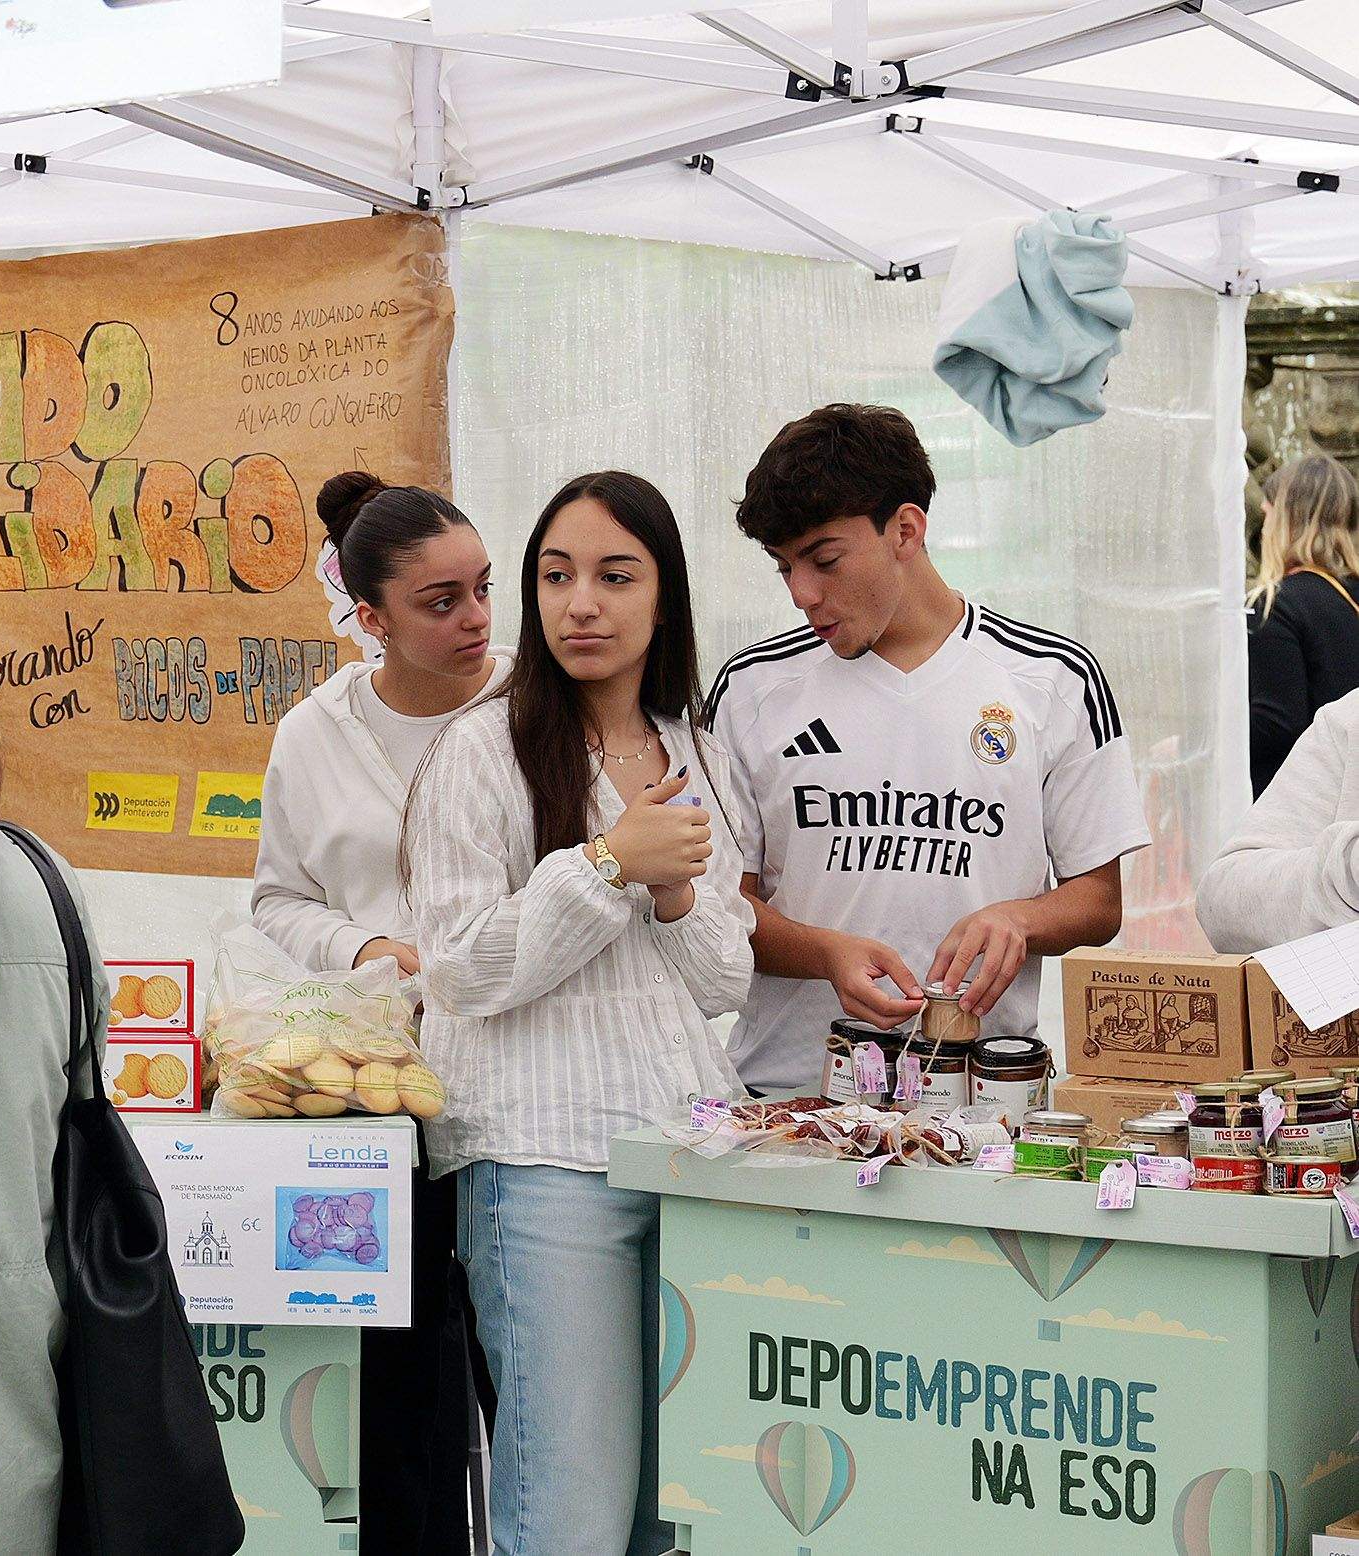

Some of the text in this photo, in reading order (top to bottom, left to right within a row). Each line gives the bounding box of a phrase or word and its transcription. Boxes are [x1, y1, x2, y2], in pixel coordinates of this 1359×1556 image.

[210, 291, 399, 346] 8 ANOS AXUDANDO AOS
[243, 333, 388, 368] NENOS DA PLANTA
[363, 358, 388, 377] DO
[235, 401, 301, 434] ÁLVARO
[215, 671, 240, 695] DE
[123, 797, 171, 809] Deputación
[123, 808, 170, 818] Pontevedra
[792, 779, 1005, 837] Emirates
[1092, 970, 1211, 988] Pastas de Nata
[309, 1144, 388, 1160] Lenda
[241, 1217, 262, 1231] 6€
[189, 1296, 234, 1304] Deputación
[189, 1303, 234, 1311] Pontevedra
[198, 1364, 266, 1423] SO
[748, 1331, 1158, 1454] DEPOEMPRENDE
[972, 1437, 1158, 1526] NA ESO
